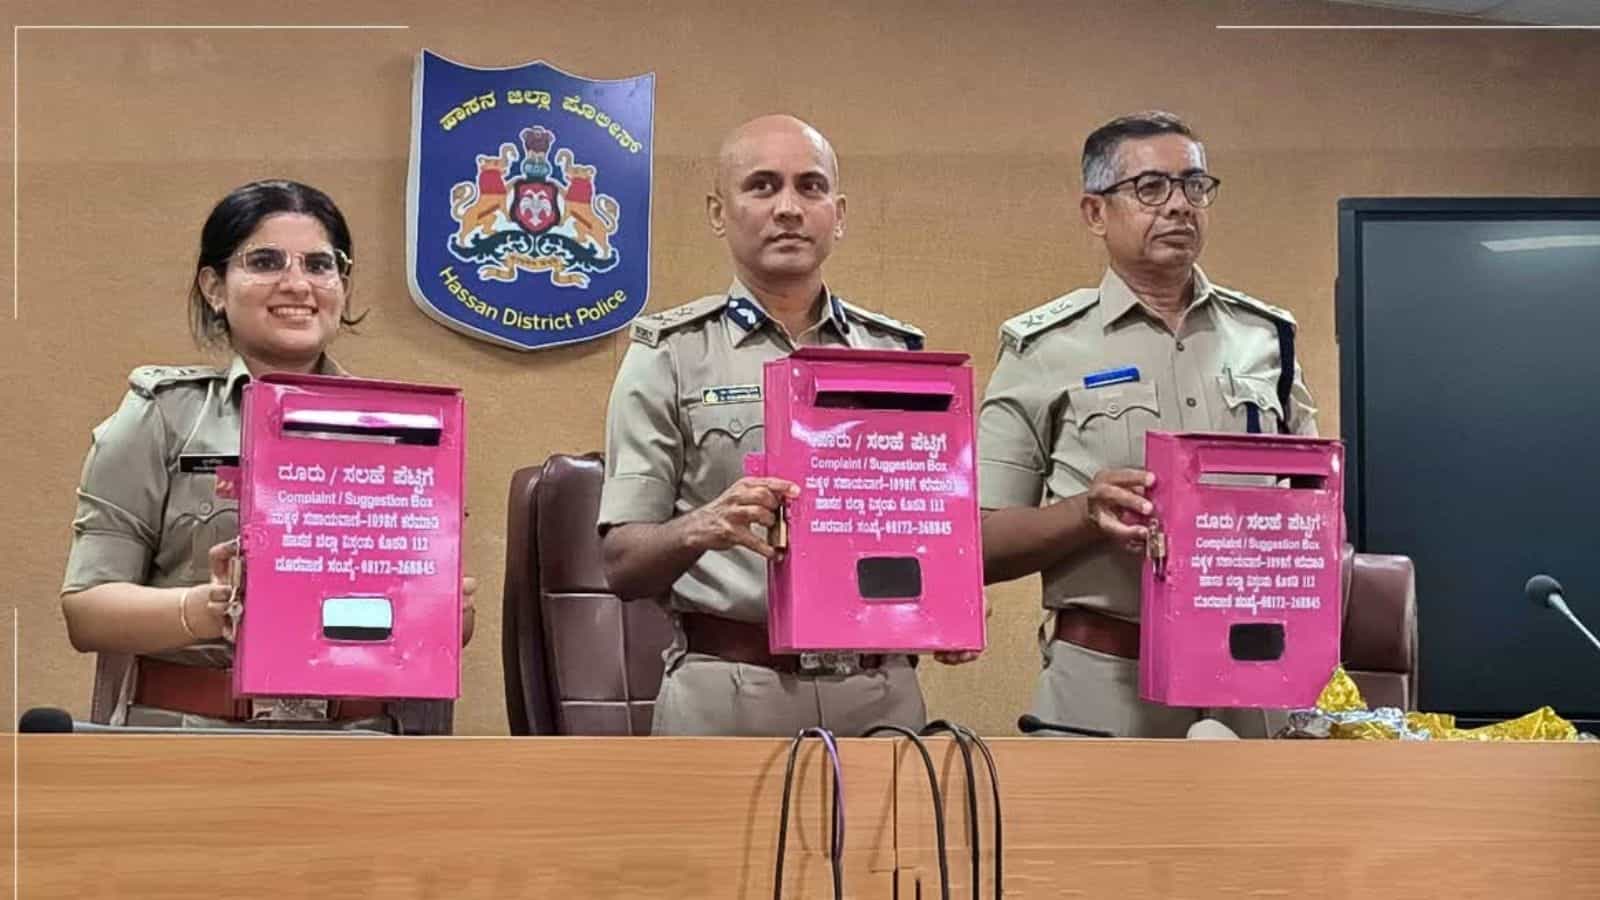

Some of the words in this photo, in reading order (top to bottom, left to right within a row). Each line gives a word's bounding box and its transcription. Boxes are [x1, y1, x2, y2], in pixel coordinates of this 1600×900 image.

[439, 90, 497, 131] ಹಾಸನ
[506, 88, 551, 111] ಜಿಲ್ಲಾ
[439, 265, 499, 320] Hassan
[502, 307, 574, 331] District
[576, 287, 628, 326] Police
[866, 431, 904, 450] ಸಲಹೆ
[278, 462, 326, 481] ದೂರು
[342, 465, 385, 484] ಸಲಹೆ
[811, 456, 861, 471] Complaint
[869, 457, 925, 473] Suggestion
[927, 459, 948, 472] Box
[278, 490, 336, 506] Complaint
[344, 492, 408, 508] Suggestion
[411, 495, 433, 507] Box
[1195, 537, 1242, 550] Complaint
[1248, 538, 1300, 552] Suggestion
[1302, 539, 1320, 550] Box
